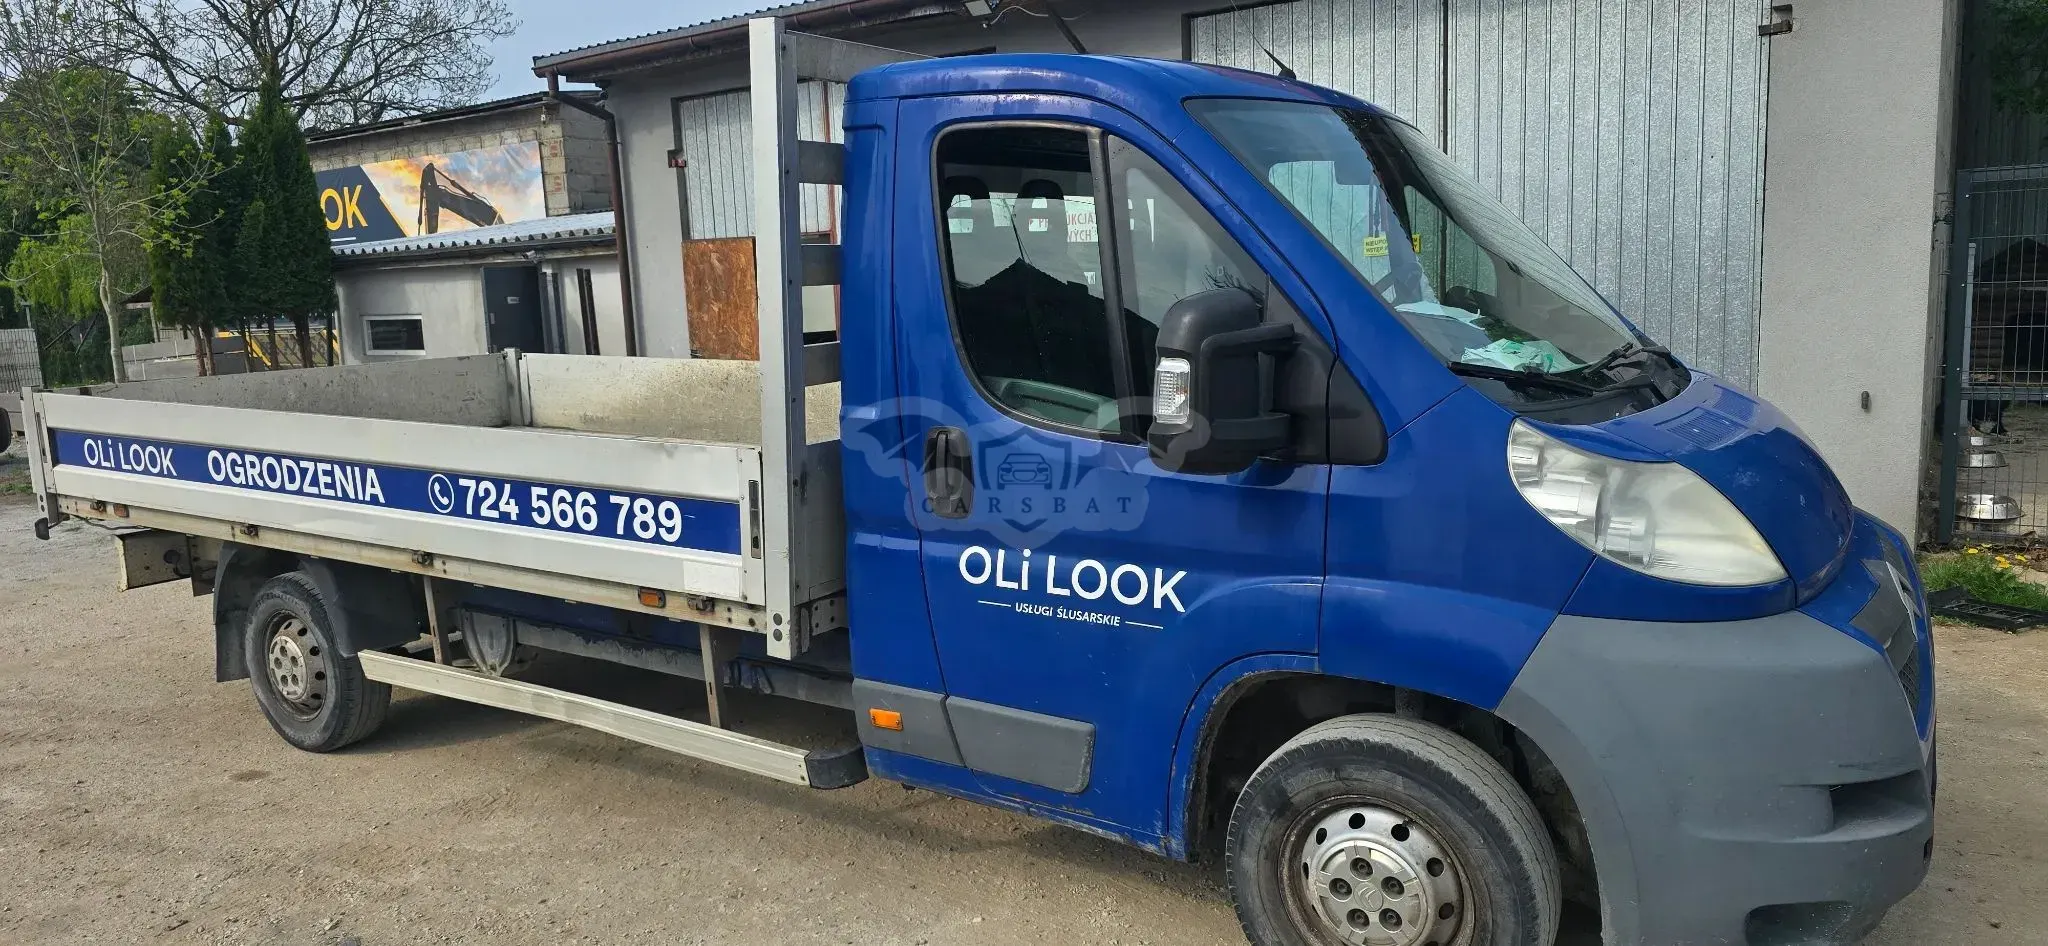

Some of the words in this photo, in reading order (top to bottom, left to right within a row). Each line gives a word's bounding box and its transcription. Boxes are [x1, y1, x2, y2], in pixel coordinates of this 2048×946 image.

[320, 185, 368, 230] OK
[83, 438, 116, 468] OLi
[118, 442, 178, 476] LOOK
[207, 449, 386, 504] OGRODZENIA
[458, 478, 520, 521] 724
[530, 486, 598, 532] 566
[609, 494, 683, 543] 789
[958, 545, 1032, 591] OLi
[1046, 554, 1188, 613] LOOK
[1015, 602, 1053, 617] USŁUGI
[1056, 605, 1121, 627] ŚLUSARSKIE
